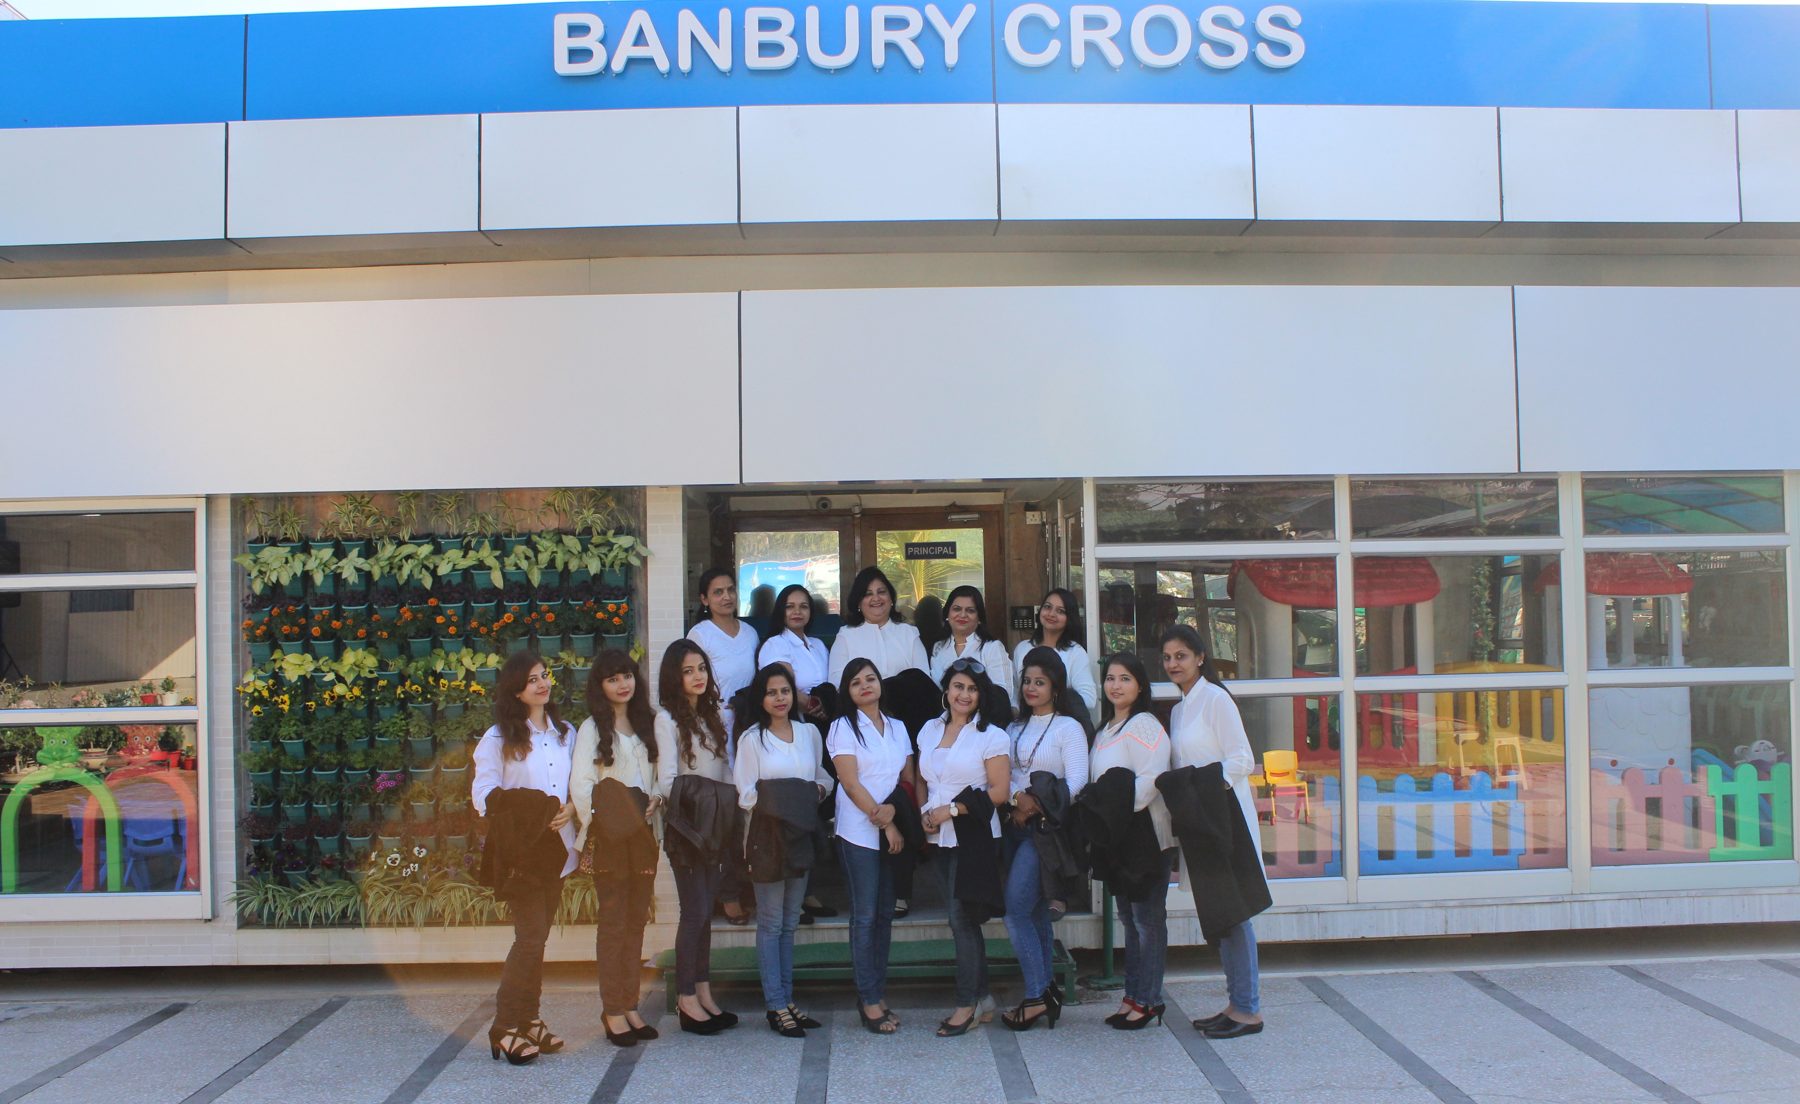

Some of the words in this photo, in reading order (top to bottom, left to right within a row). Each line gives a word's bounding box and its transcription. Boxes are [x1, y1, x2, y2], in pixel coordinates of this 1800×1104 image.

[553, 3, 977, 76] BANBURY
[1003, 3, 1306, 69] CROSS
[907, 546, 954, 556] PRINCIPAL
